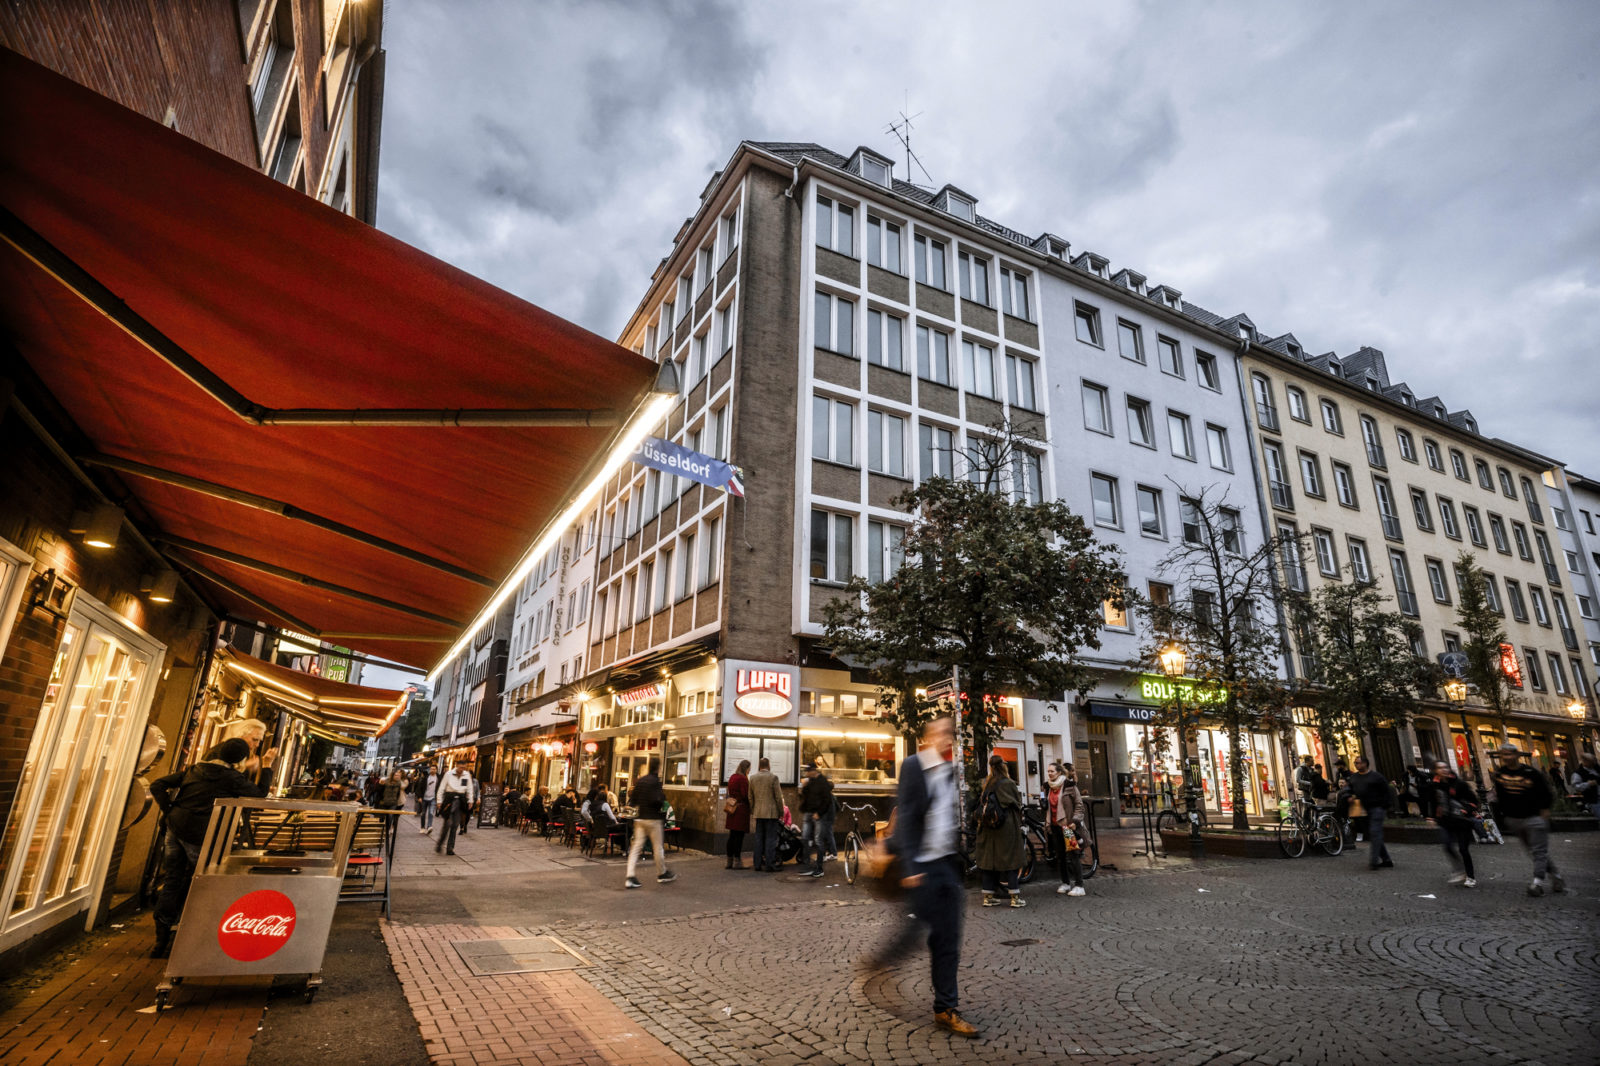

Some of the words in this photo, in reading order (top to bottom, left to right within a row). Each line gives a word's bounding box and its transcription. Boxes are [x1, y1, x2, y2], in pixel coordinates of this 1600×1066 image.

[559, 546, 571, 584] HOTEL
[552, 608, 564, 646] GEORG
[327, 669, 345, 681] PUB
[736, 669, 792, 698] LUPO
[1197, 687, 1228, 704] SHP
[1042, 715, 1052, 723] 52
[221, 912, 295, 937] Coca-Cola
